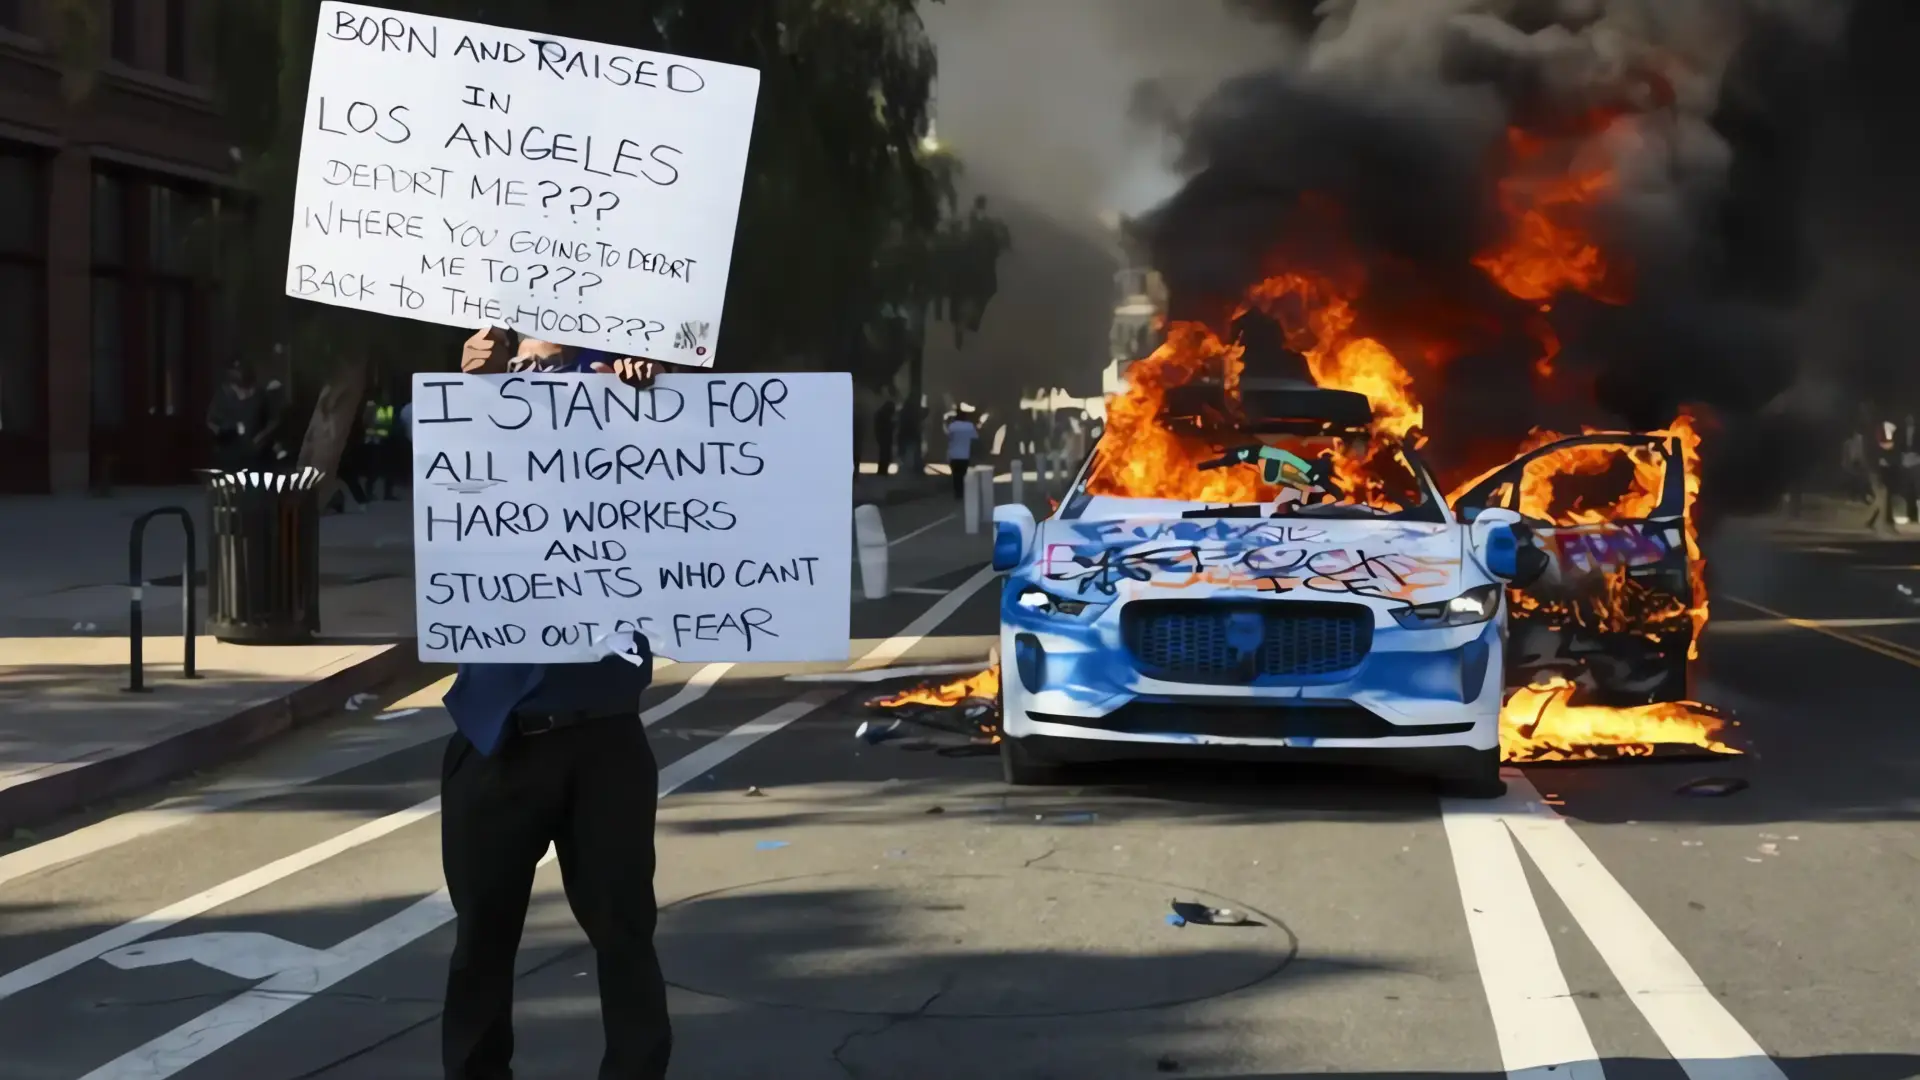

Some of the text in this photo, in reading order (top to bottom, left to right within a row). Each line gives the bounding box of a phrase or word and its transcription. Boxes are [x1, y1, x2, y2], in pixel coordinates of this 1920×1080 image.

[328, 10, 705, 93] BORN AND RAISED
[462, 85, 511, 114] IN
[318, 96, 683, 186] LOS ANGELES
[323, 159, 454, 199] DEPORT
[305, 200, 697, 283] WHERE YOU GOING TO DEPORT
[421, 255, 465, 277] ME
[292, 264, 376, 301] BACK
[443, 286, 502, 320] THE
[418, 377, 788, 430] I STAND FOR
[425, 441, 765, 485] ALL MIGRANTS
[427, 498, 737, 541] HARD WORKERS
[544, 539, 627, 562] AND
[425, 557, 819, 605] STUDENTS WHO CANT
[425, 621, 526, 654] STAND
[541, 622, 599, 647] OUT
[673, 607, 779, 652] FEAR
